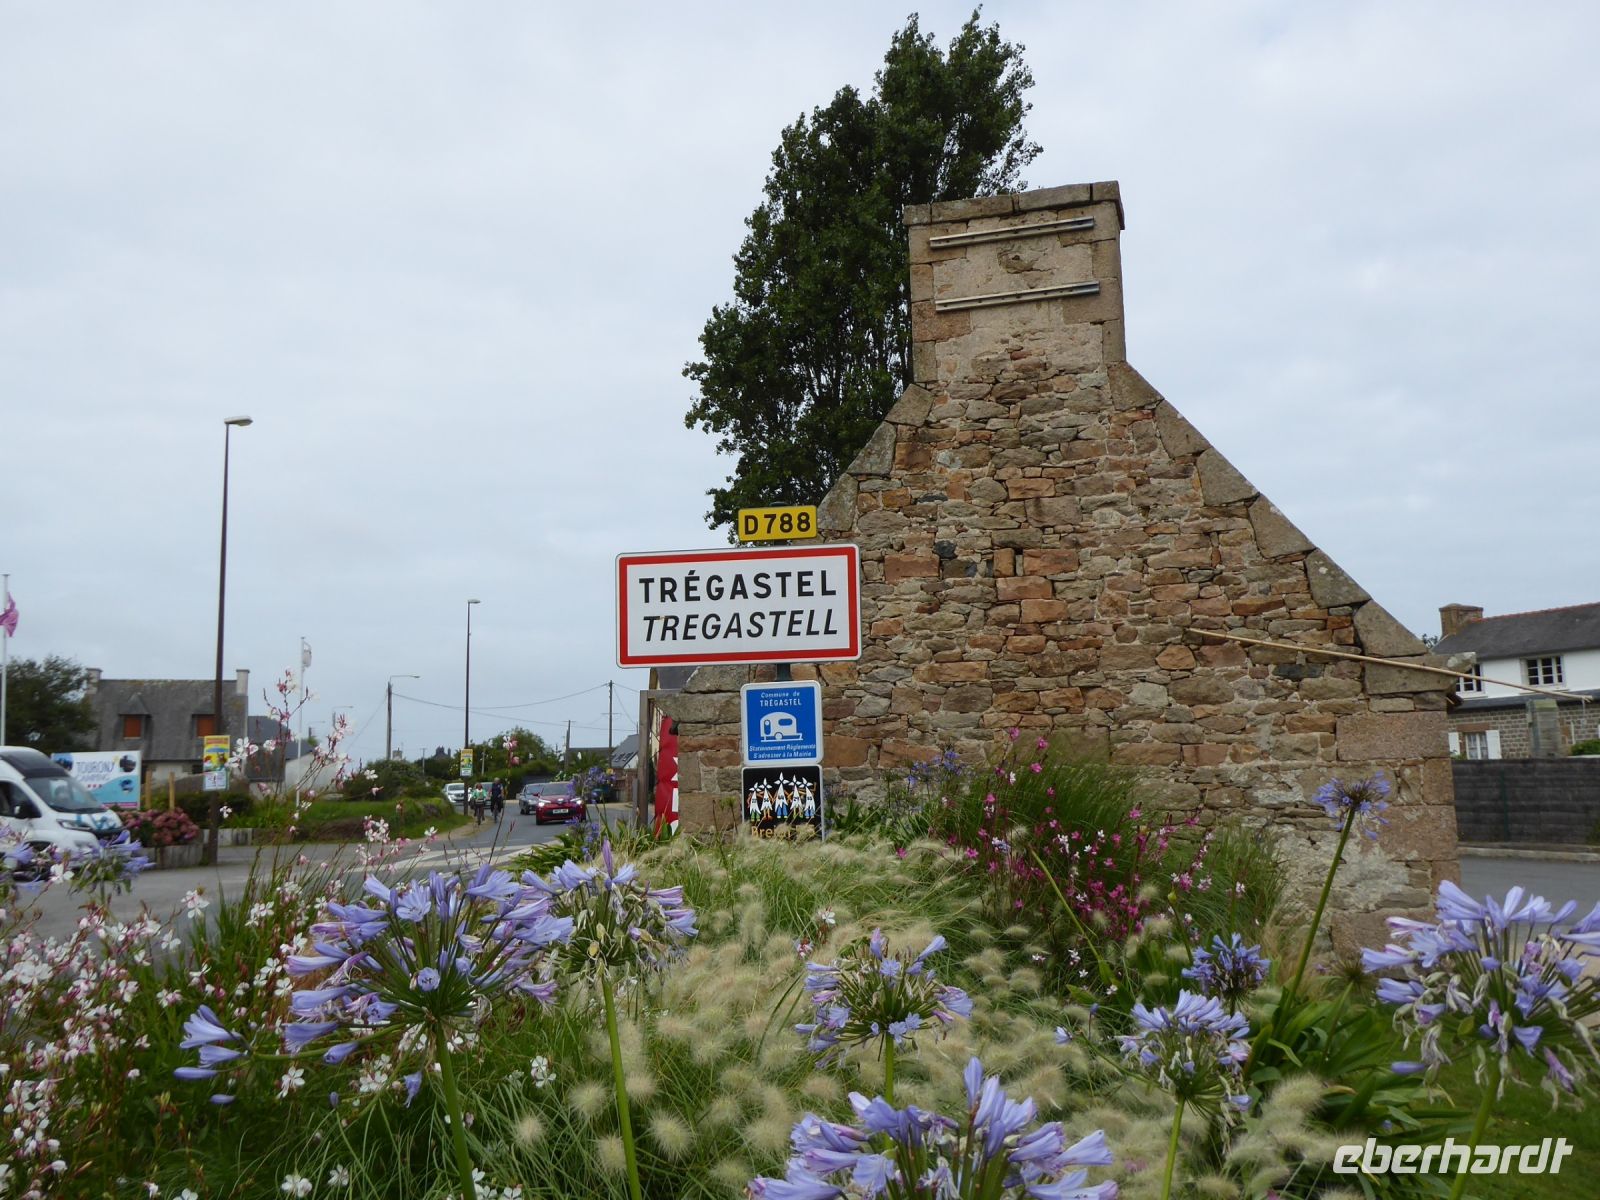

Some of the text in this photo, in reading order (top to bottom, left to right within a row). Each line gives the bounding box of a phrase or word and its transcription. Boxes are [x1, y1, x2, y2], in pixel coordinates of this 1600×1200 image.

[744, 511, 811, 536] D788
[638, 569, 837, 603] TRÉGASTEL
[643, 609, 838, 642] TREGASTELL
[760, 698, 802, 707] TRÉGASTEL
[793, 750, 812, 758] Mairie
